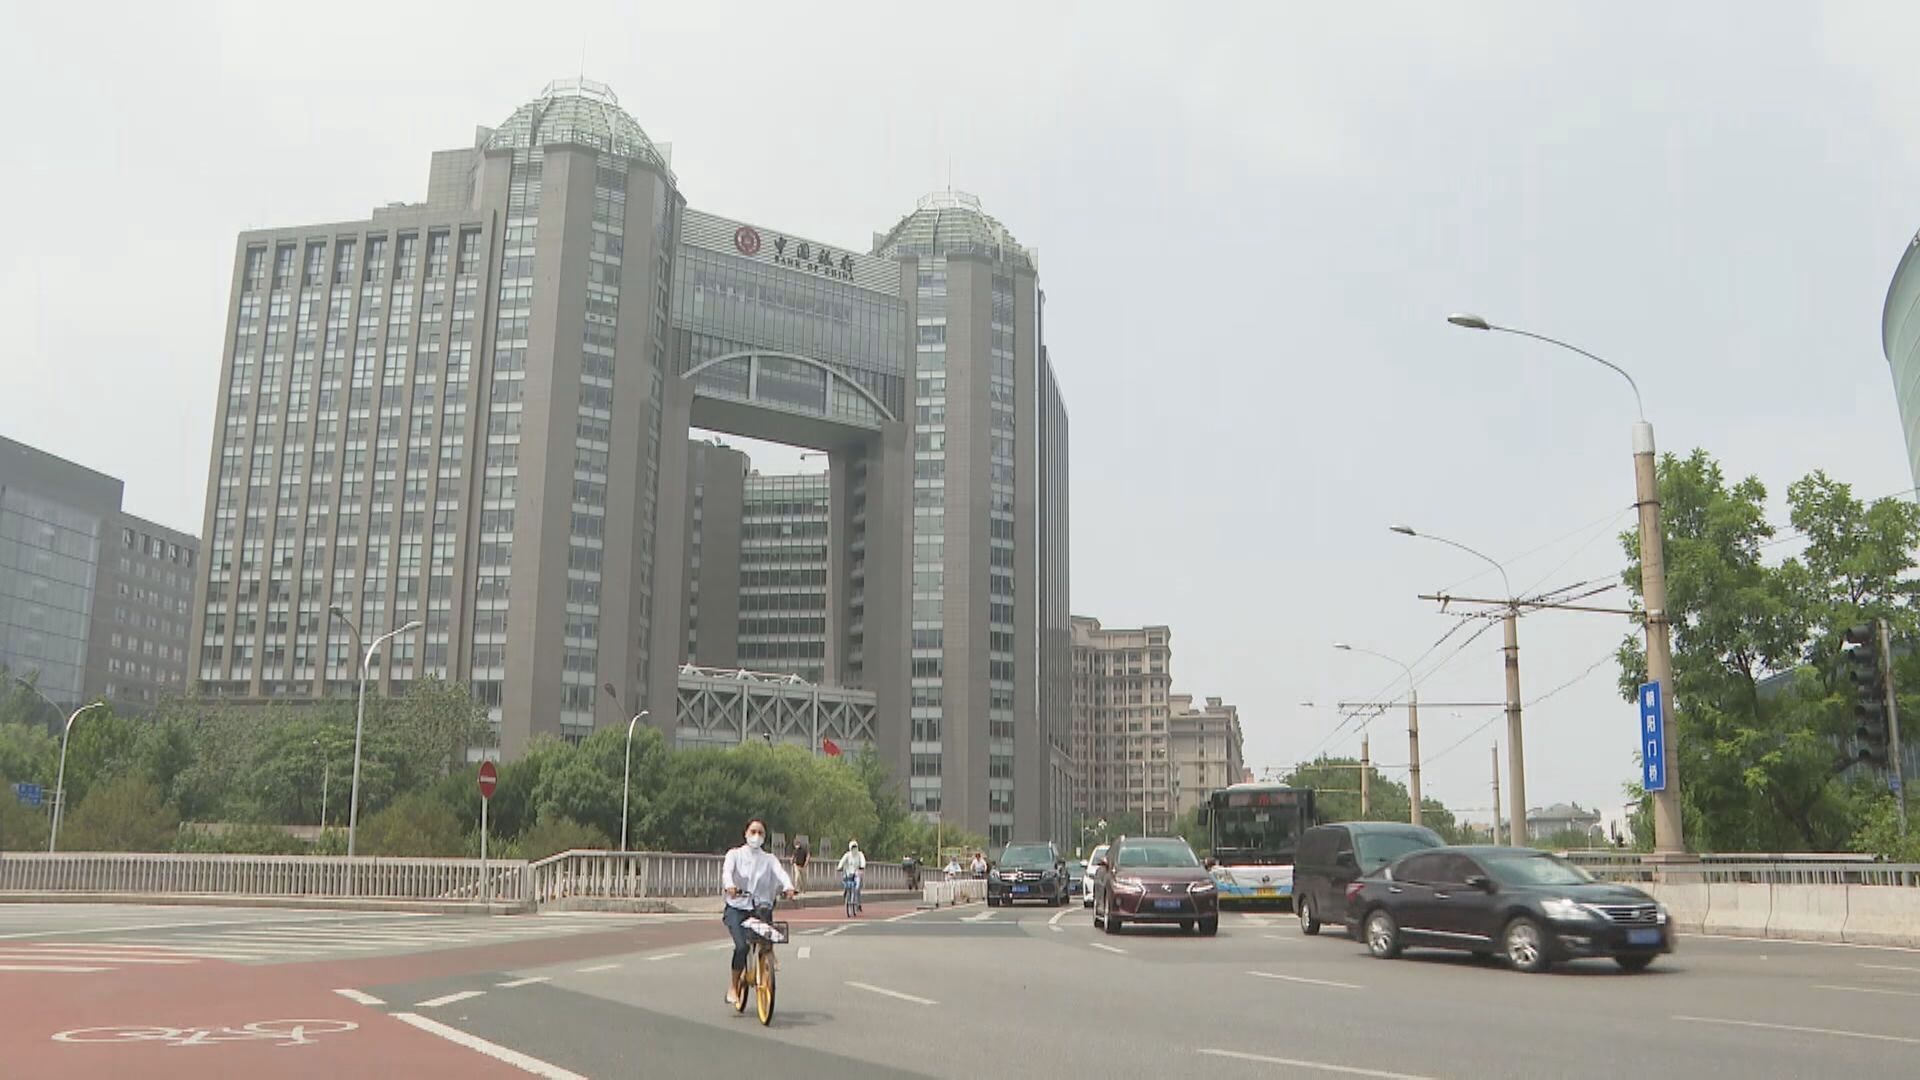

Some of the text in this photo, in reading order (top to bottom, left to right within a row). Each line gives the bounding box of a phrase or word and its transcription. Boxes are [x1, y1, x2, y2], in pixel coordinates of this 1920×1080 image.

[774, 255, 855, 282] BANK OF CHINA
